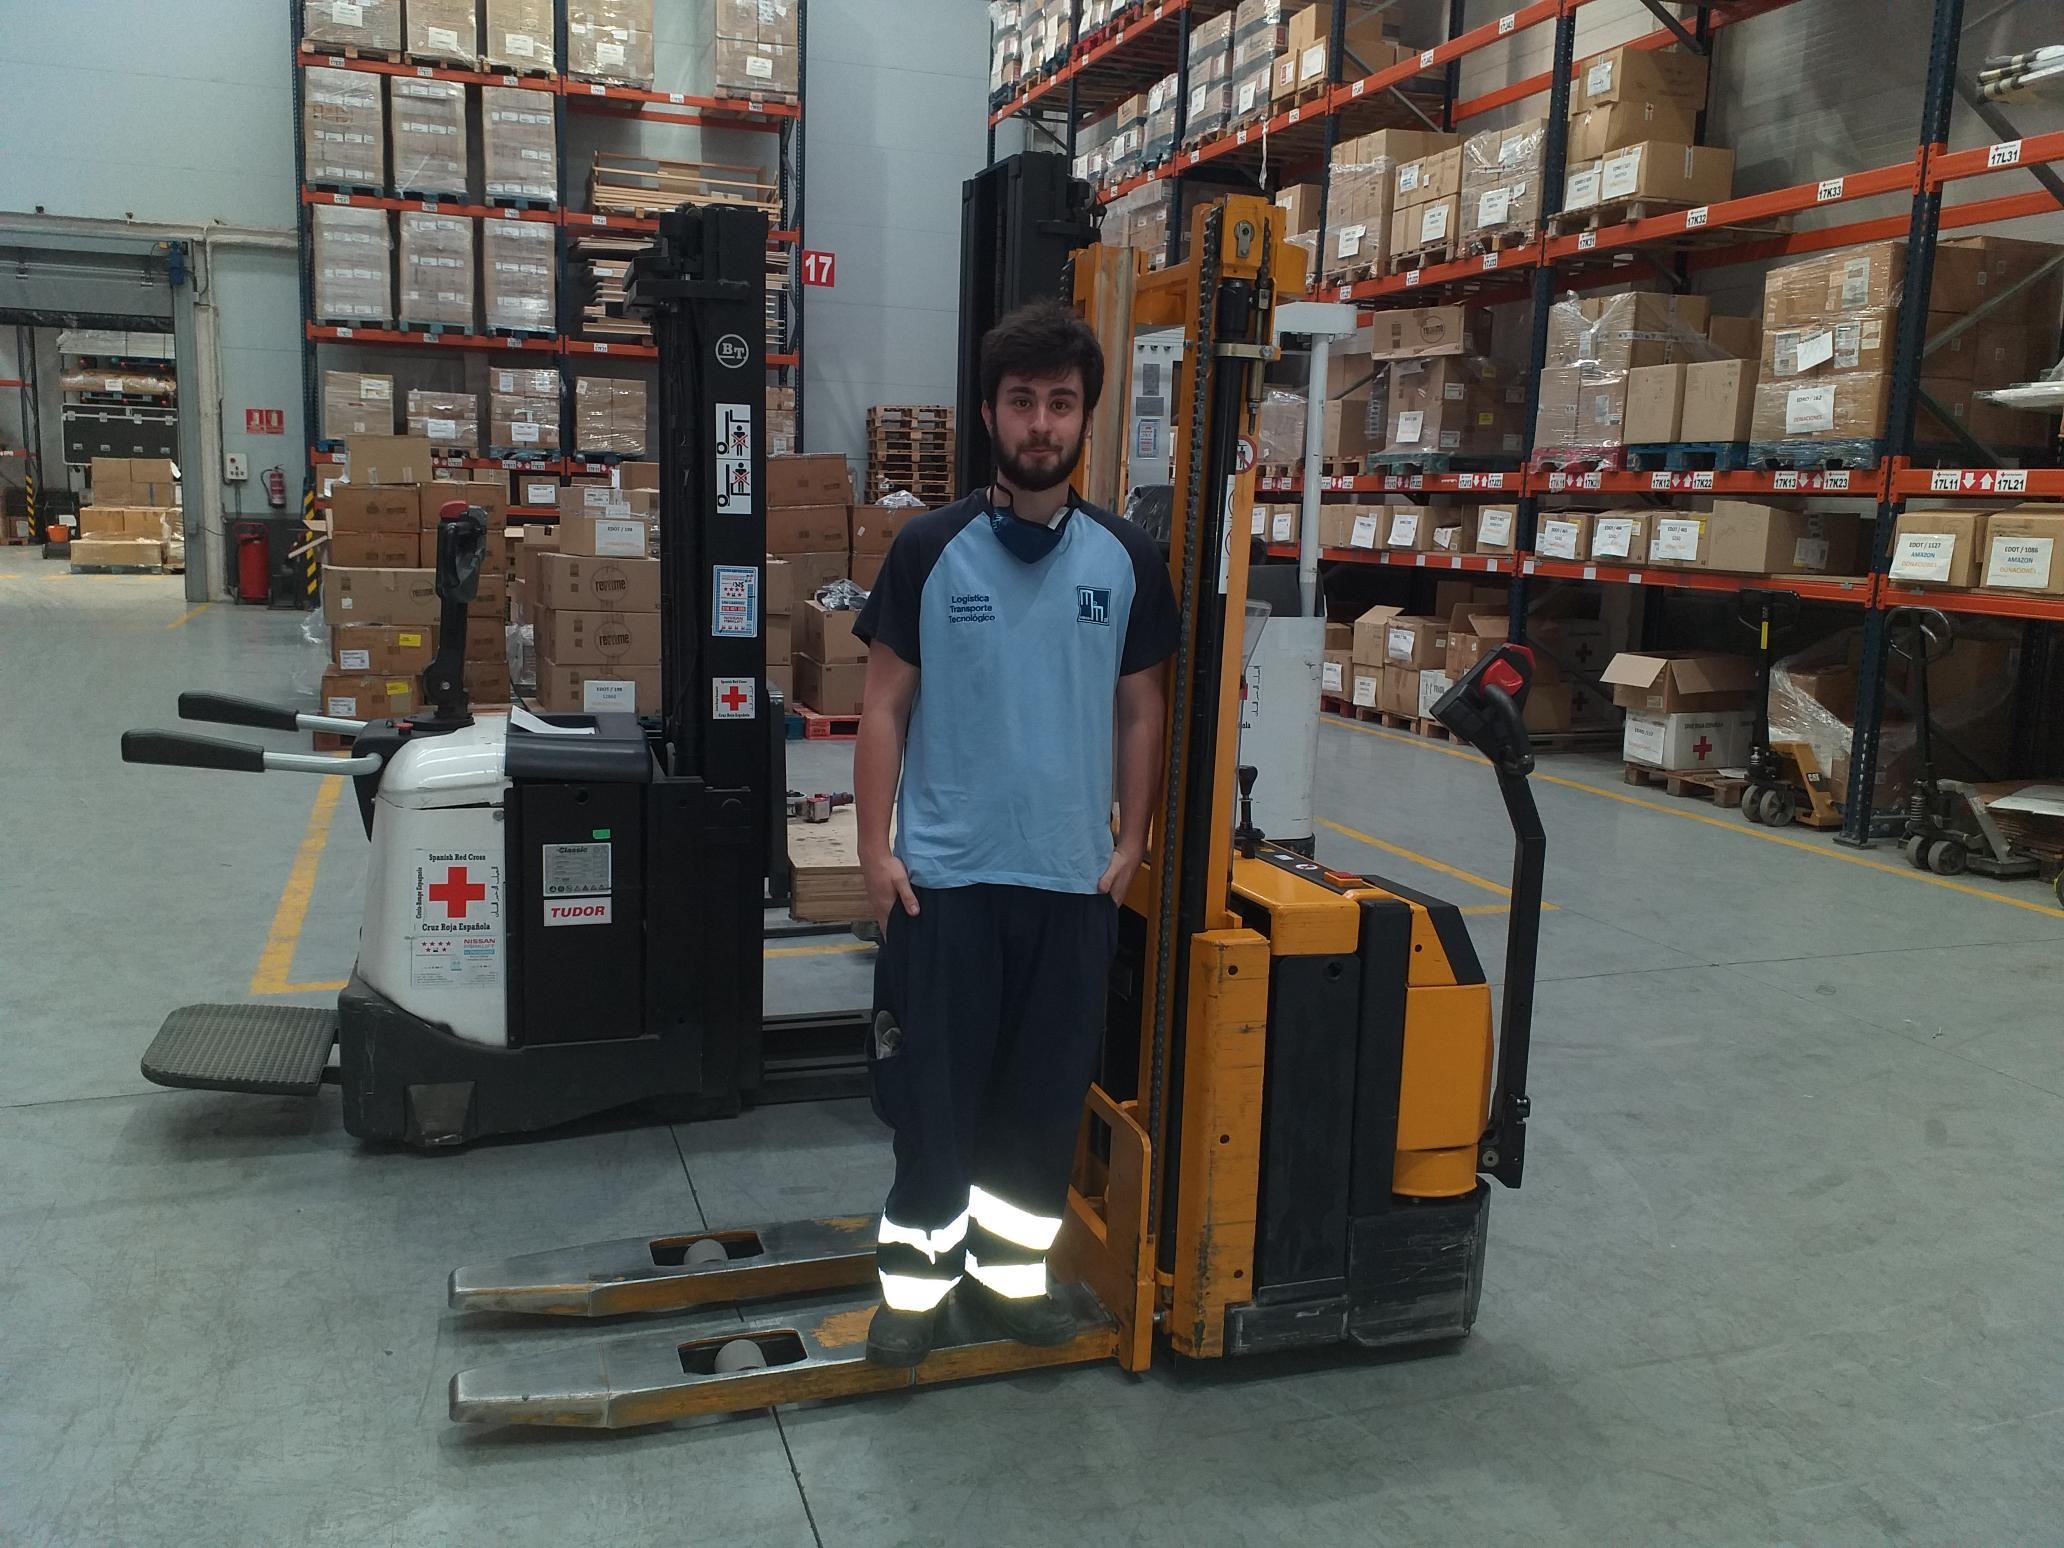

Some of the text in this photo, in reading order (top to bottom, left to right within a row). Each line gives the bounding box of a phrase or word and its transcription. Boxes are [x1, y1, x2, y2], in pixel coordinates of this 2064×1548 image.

[1991, 149, 2018, 165] 17L31
[1819, 185, 1842, 200] 17K33
[1687, 214, 1707, 227] 17K32
[805, 254, 832, 283] 17
[1652, 479, 1670, 488] 17K12
[1693, 479, 1713, 488] 17K22
[1775, 478, 1796, 488] 17K13
[1825, 478, 1848, 488] 17K23
[1933, 478, 1958, 490] 17L11
[1997, 478, 2024, 490] 17L21
[1908, 541, 1924, 549] EDOT
[1910, 551, 1936, 559] AMAZON
[2007, 556, 2033, 564] AMAZON
[949, 605, 992, 613] Transporte
[948, 614, 996, 623] Tecnológico
[429, 854, 453, 862] Spanish
[551, 906, 606, 918] TUDOR
[441, 924, 457, 932] Roja
[458, 923, 491, 932] Española
